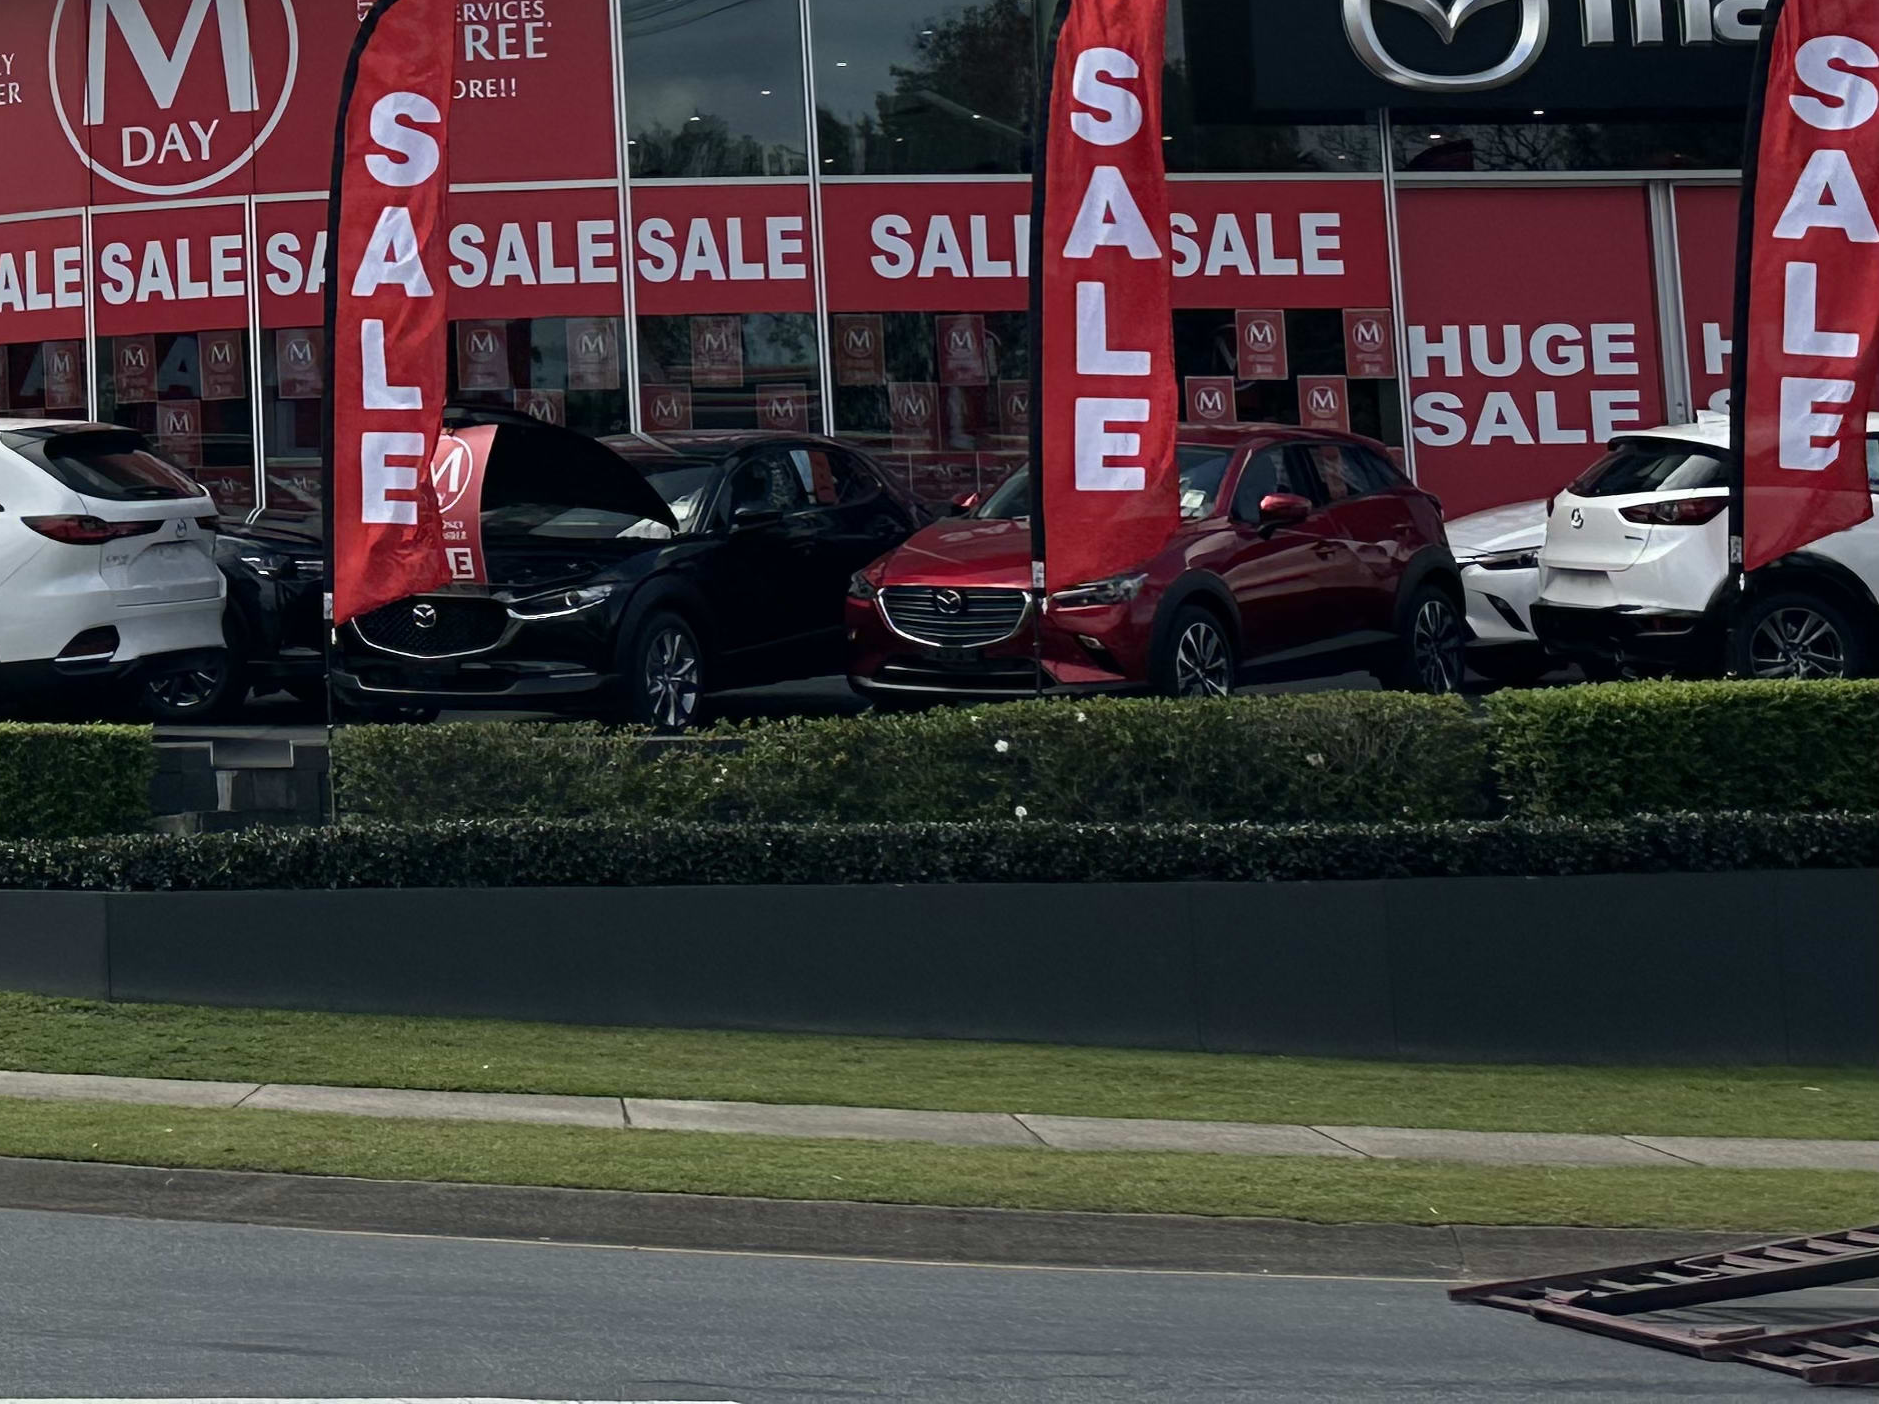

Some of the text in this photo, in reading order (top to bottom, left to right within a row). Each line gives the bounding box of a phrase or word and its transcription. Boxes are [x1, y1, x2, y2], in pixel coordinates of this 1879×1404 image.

[122, 120, 219, 167] DAY
[101, 235, 245, 307] SALE
[448, 219, 617, 290] SALE
[637, 216, 806, 282] SALE
[1063, 47, 1162, 491] SALE
[1171, 213, 1345, 278] SALE
[1771, 34, 1879, 472] SALE
[351, 92, 442, 526] SALE
[1408, 323, 1639, 378] HUGE
[1414, 389, 1640, 446] SALE
